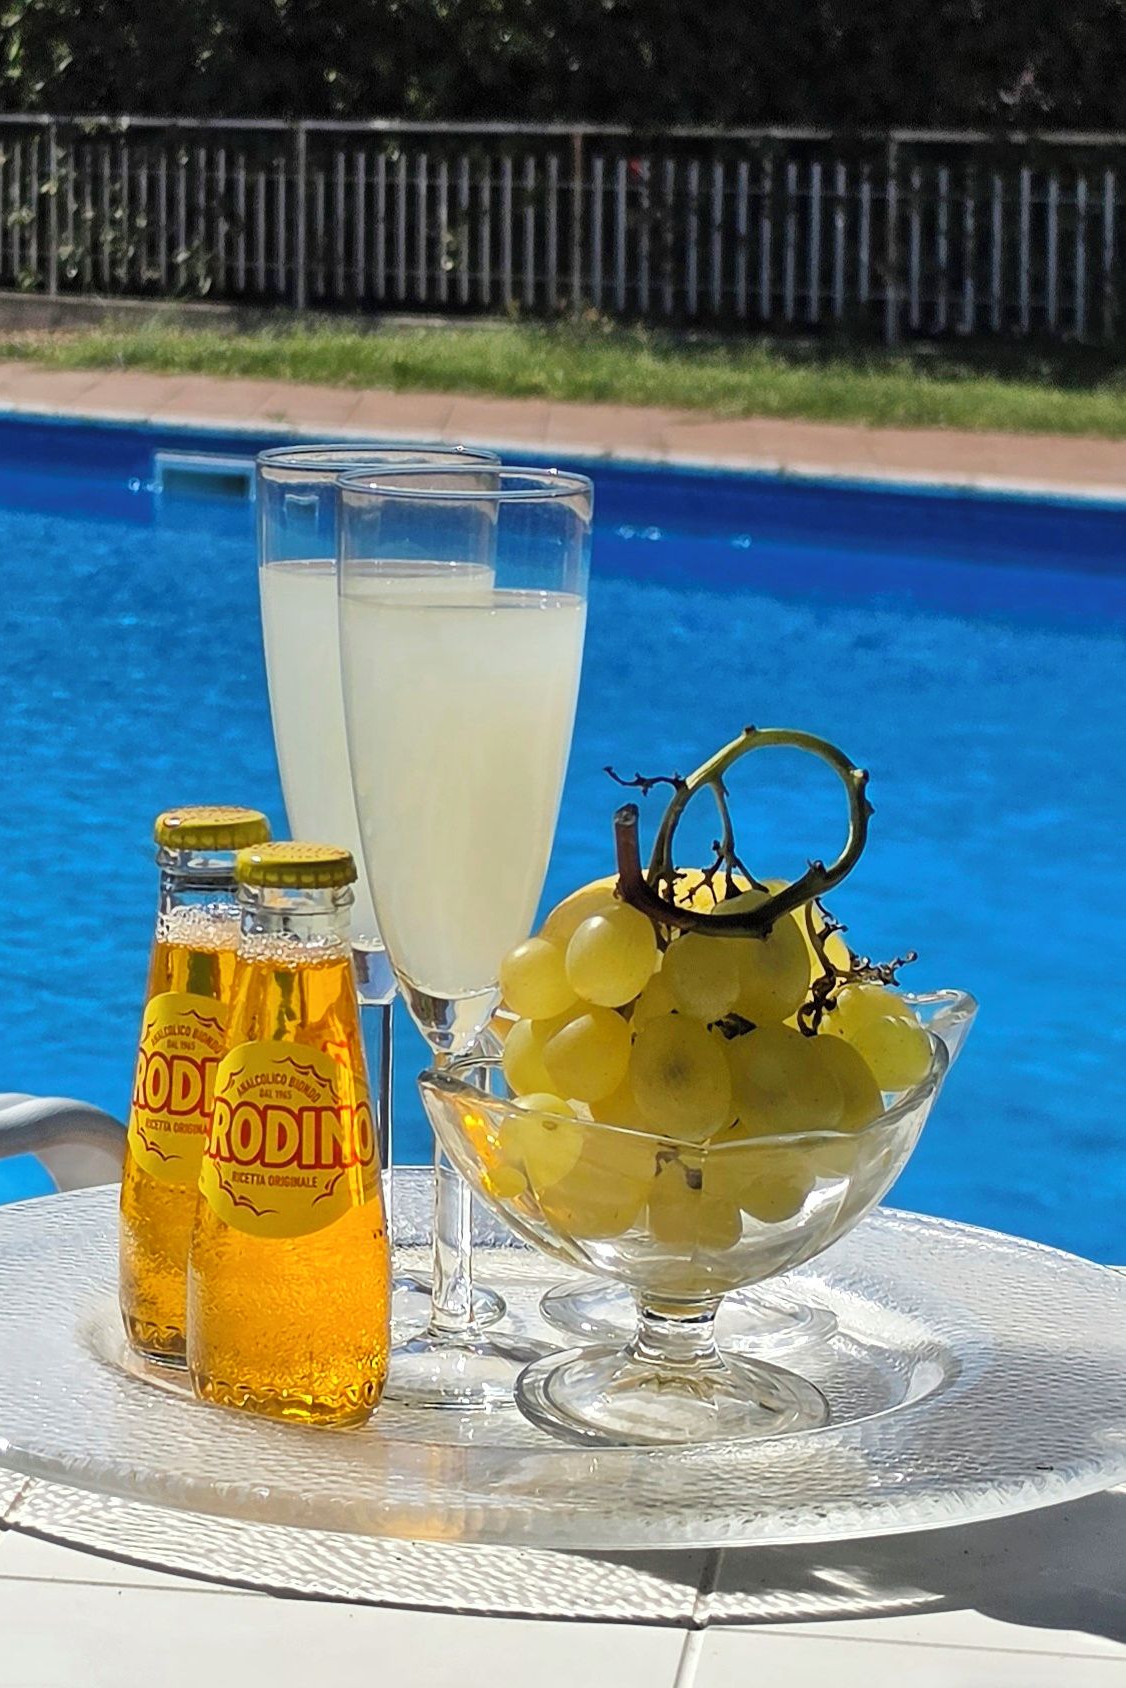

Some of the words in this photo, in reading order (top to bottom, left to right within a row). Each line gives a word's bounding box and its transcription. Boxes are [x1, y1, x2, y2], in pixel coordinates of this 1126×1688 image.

[133, 1047, 218, 1118] RODI
[236, 1072, 287, 1098] ANALCOLICO
[288, 1075, 321, 1104] BIONDO
[259, 1087, 272, 1099] DAL
[274, 1090, 292, 1100] 1965
[145, 1119, 171, 1132] RICETTA
[203, 1095, 375, 1169] RODINO
[232, 1171, 266, 1186] RICETTA
[268, 1174, 318, 1189] ORIGINALE
